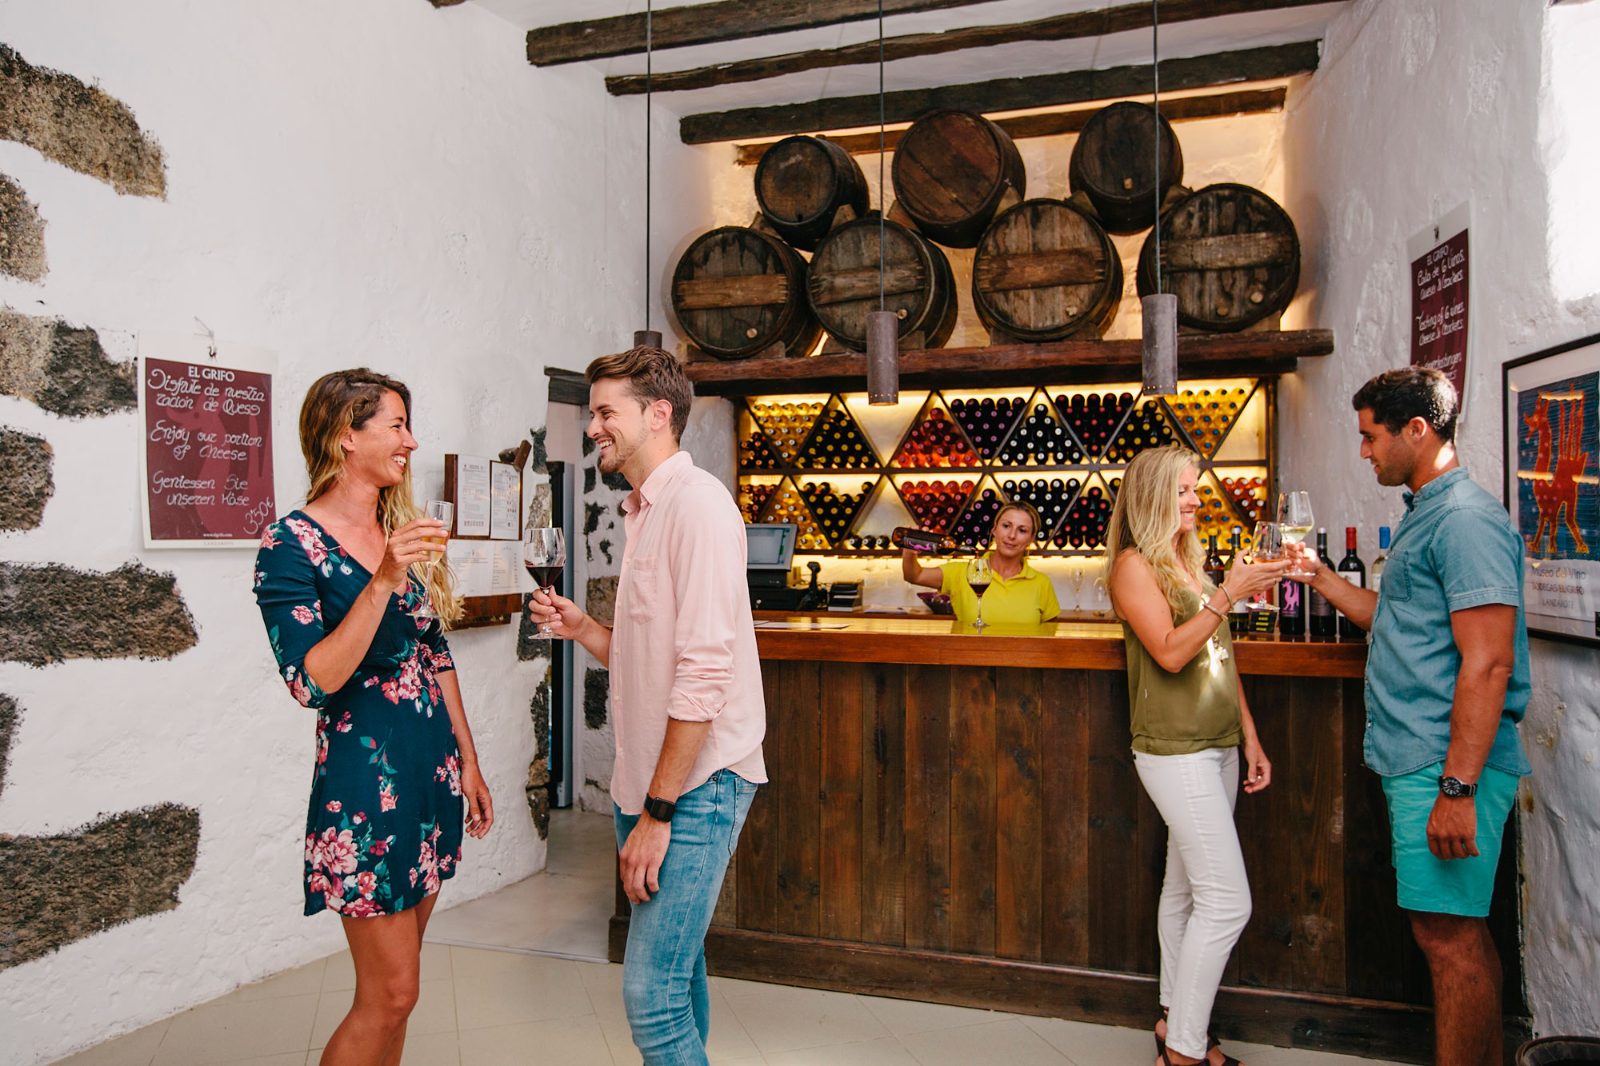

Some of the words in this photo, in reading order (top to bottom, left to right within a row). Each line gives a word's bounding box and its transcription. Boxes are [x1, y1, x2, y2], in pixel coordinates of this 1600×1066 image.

[147, 368, 202, 396] Disfrute
[204, 382, 220, 397] de
[224, 386, 265, 402] nuestra
[188, 366, 200, 379] EL
[202, 368, 235, 382] GRIFO
[203, 397, 219, 412] de
[150, 419, 190, 446] Enjoy
[197, 431, 218, 443] our
[222, 432, 263, 448] portion
[152, 470, 216, 494] Geniessen
[224, 474, 249, 490] Sie
